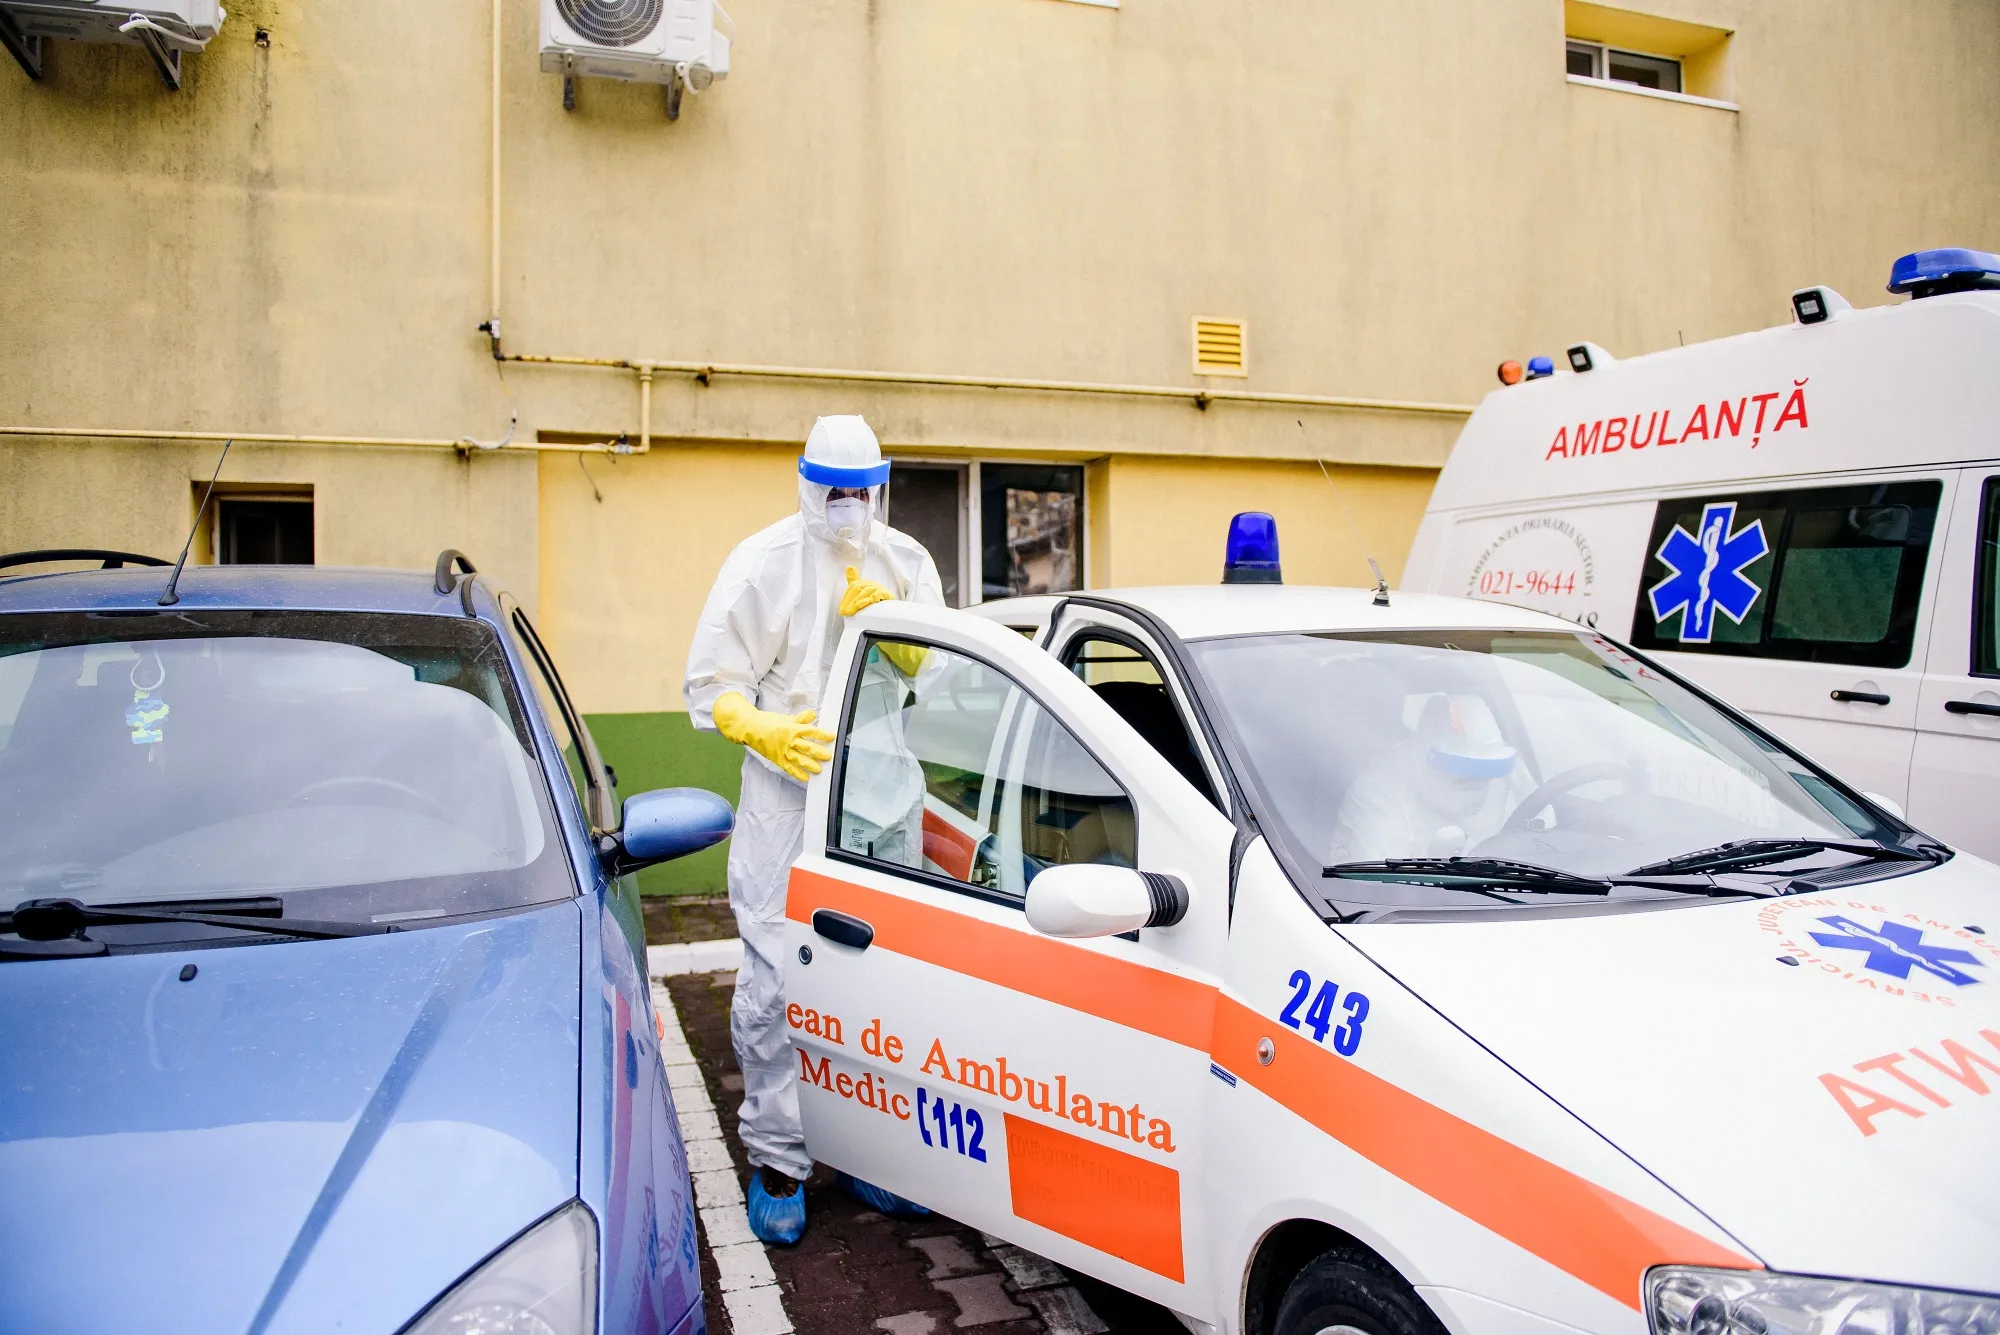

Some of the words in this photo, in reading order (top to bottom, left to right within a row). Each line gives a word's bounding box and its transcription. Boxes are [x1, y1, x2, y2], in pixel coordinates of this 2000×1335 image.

[1480, 569, 1577, 596] 021-9644
[1757, 899, 1837, 936] JUDETEAN
[1847, 901, 1888, 914] DE
[1279, 969, 1370, 1057] 243
[786, 1001, 844, 1046] ean
[861, 1018, 904, 1064] de
[920, 1038, 1177, 1154] Ambulanta
[796, 1047, 911, 1121] Medic
